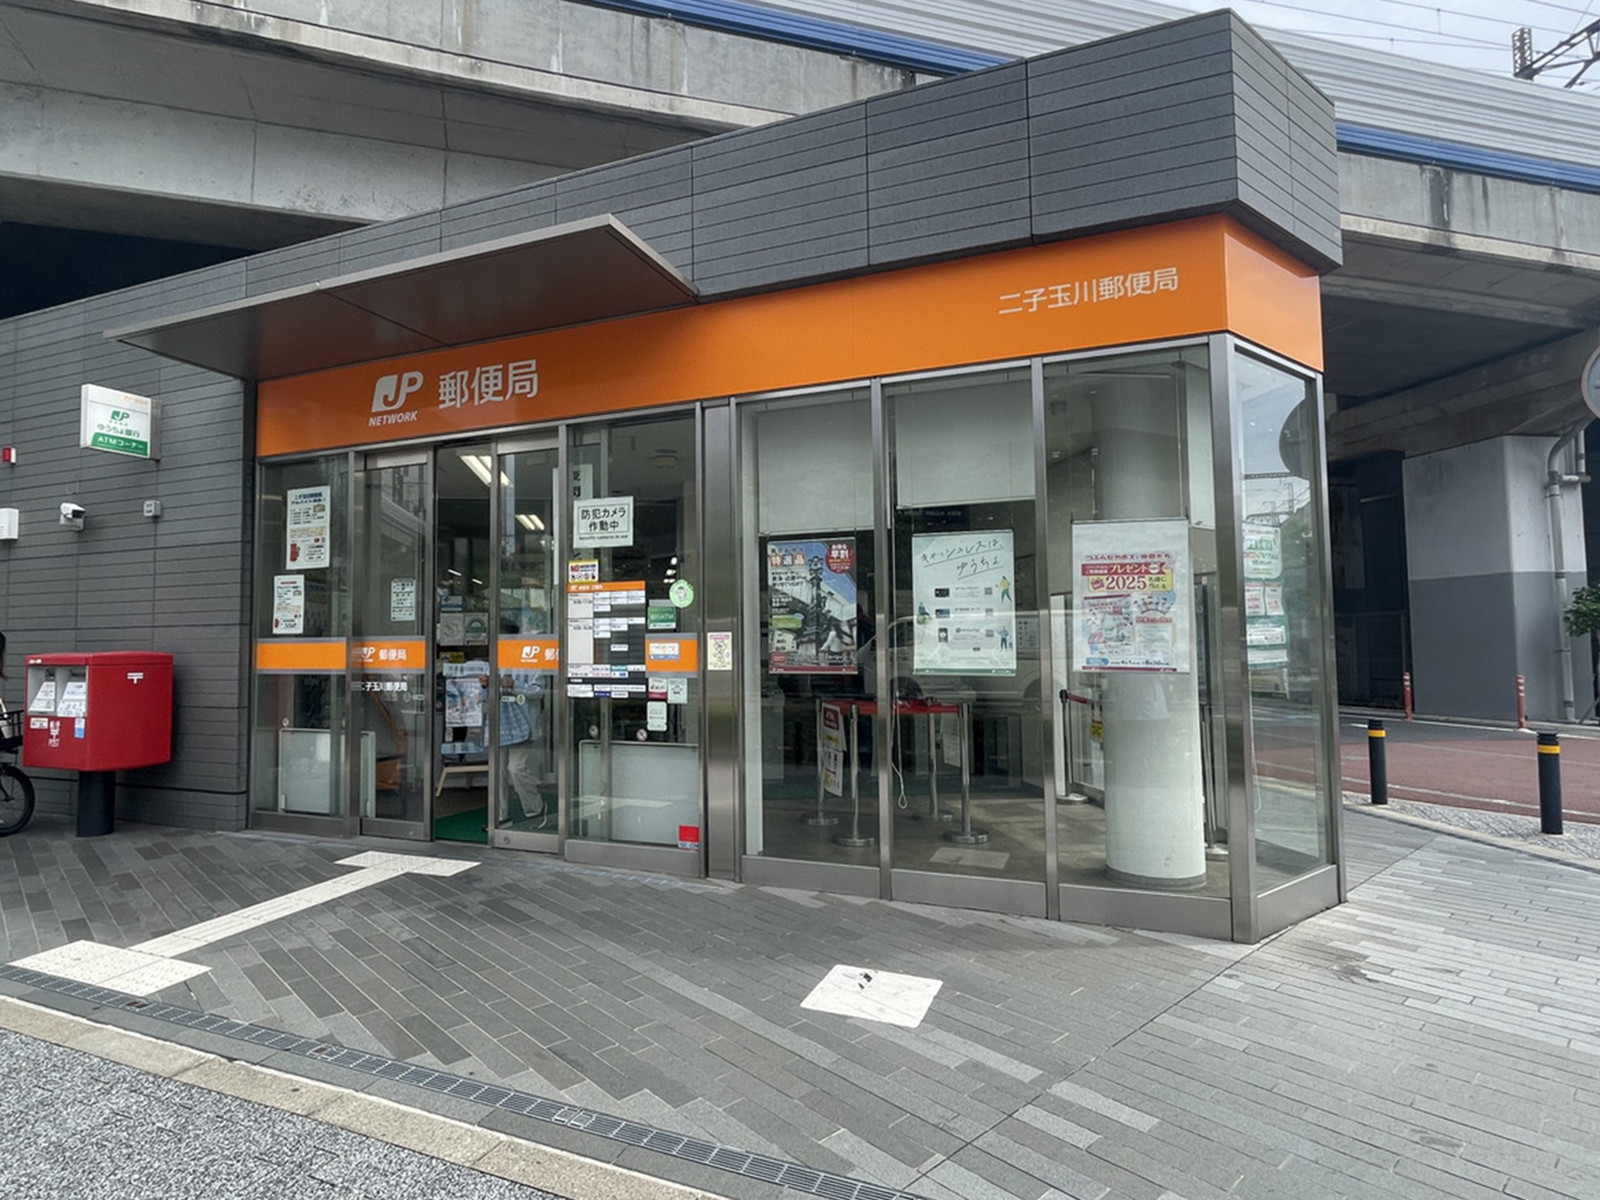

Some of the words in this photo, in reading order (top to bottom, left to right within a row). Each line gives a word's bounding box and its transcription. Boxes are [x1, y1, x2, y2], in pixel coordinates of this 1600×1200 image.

[998, 267, 1179, 315] 二子玉川郵便局
[438, 359, 539, 409] 郵便局
[368, 411, 418, 427] NETWORK
[97, 435, 145, 449] ATMコーナー
[581, 506, 627, 521] 防犯カメラ
[589, 520, 619, 532] 作動中
[1109, 564, 1148, 574] プレゼント
[1106, 575, 1147, 590] 2025
